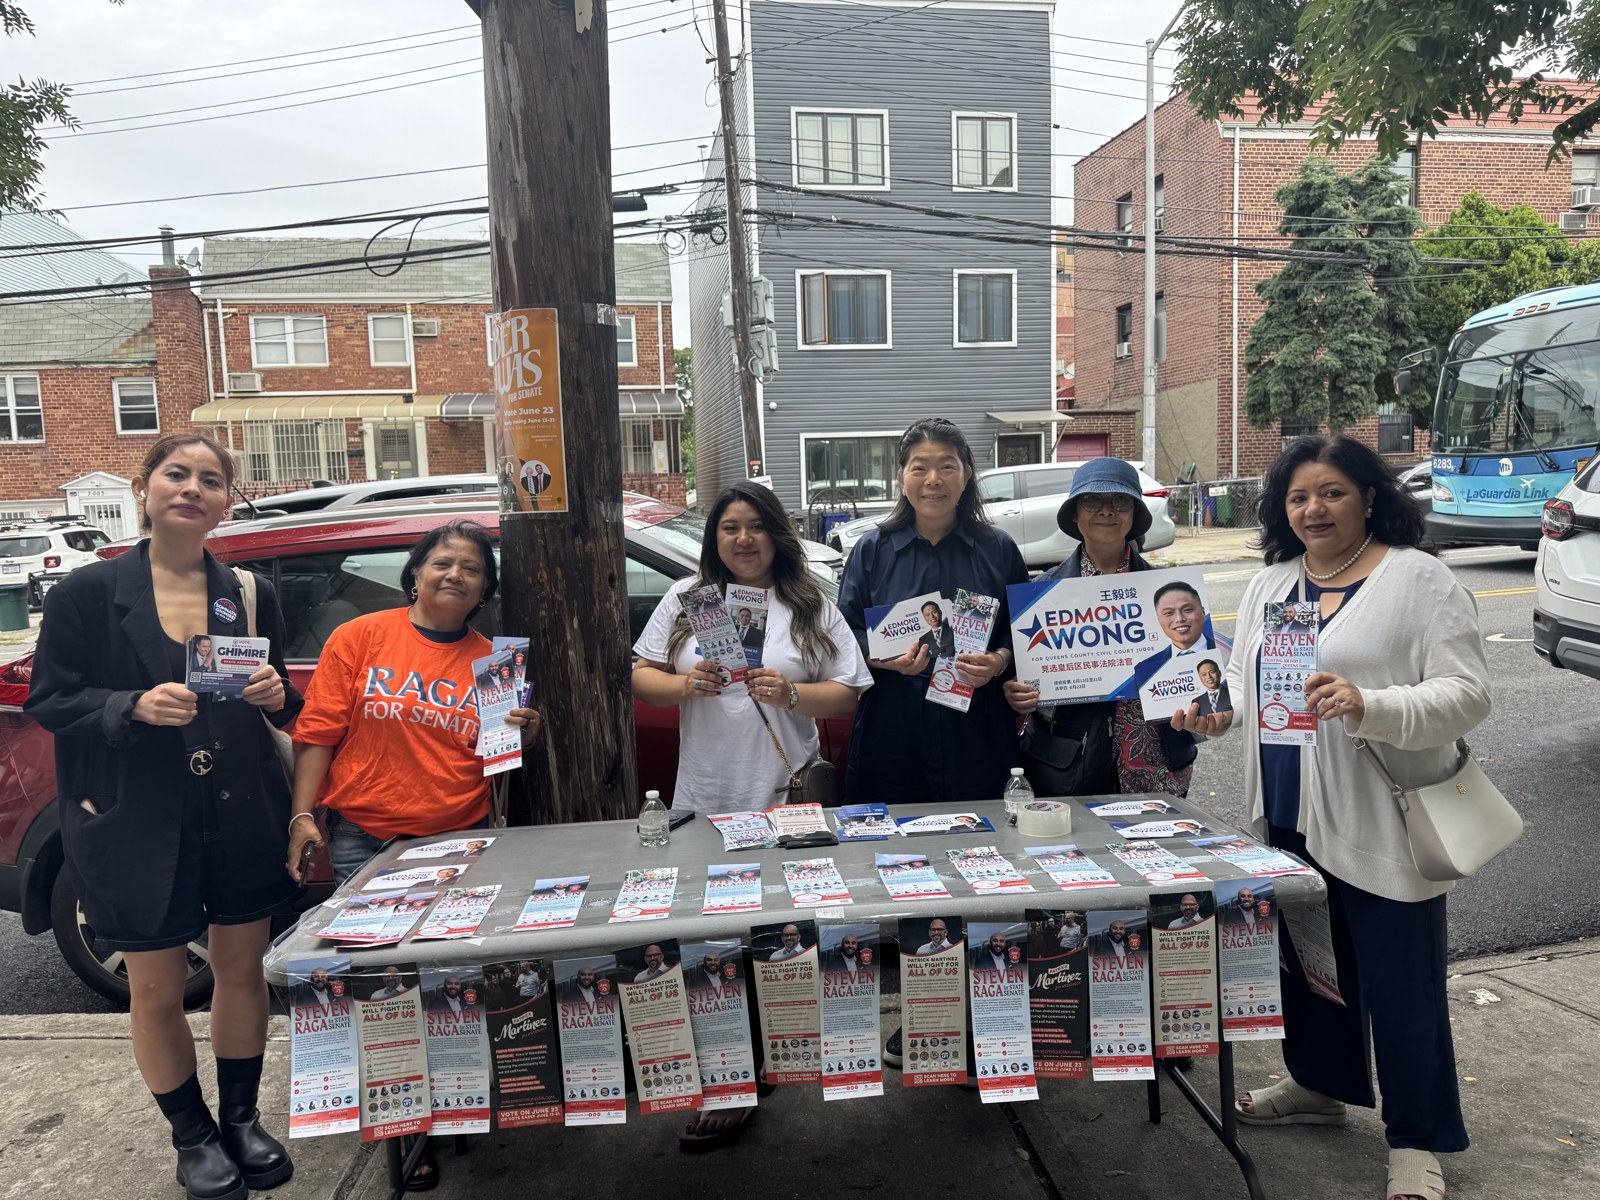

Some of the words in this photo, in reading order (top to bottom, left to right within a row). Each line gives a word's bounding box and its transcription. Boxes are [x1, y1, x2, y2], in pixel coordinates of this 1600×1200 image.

[518, 387, 542, 399] SENATE
[504, 409, 517, 417] Vote
[543, 406, 554, 414] 23
[1433, 458, 1452, 469] 6283
[1500, 462, 1510, 472] MTA
[1466, 487, 1521, 500] LaGuardia
[1524, 487, 1549, 500] Link
[738, 589, 763, 597] EDMOND
[738, 594, 763, 604] WONG
[690, 607, 728, 624] STEVEN
[1045, 603, 1142, 627] EDMOND
[693, 621, 717, 633] RAGA
[888, 617, 919, 630] EDMOND
[889, 623, 921, 637] WONG
[952, 614, 989, 633] STEVEN
[953, 625, 969, 637] AGA
[1048, 621, 1146, 650] WONG
[1264, 633, 1315, 646] STEVEN
[217, 647, 266, 658] GHIMIRE
[1264, 646, 1293, 656] RAGA
[1041, 658, 1133, 673] 竞选皇后区民事法院法官
[1157, 676, 1193, 688] EDMOND
[363, 667, 480, 717] RAGA
[480, 681, 513, 699] STEVEN
[1160, 683, 1195, 696] WONG
[481, 695, 500, 708] RAGA
[364, 701, 403, 720] FOR
[409, 705, 480, 740] SENATE
[1222, 921, 1274, 938] STEVEN
[1159, 942, 1178, 950] ALL
[1180, 941, 1193, 949] OF
[1222, 936, 1253, 950] RAGA
[1092, 955, 1144, 970] STEVEN
[762, 974, 781, 982] ALL
[800, 971, 813, 979] US
[824, 970, 875, 987] STEVEN
[907, 969, 927, 977] ALL
[928, 968, 943, 976] OF
[945, 967, 958, 975] US
[973, 969, 1024, 985] STEVEN
[1092, 970, 1123, 983] RAGA
[626, 984, 648, 992] PATRICK
[650, 979, 677, 987] MARTINEZ
[1029, 972, 1082, 990] Martinez
[628, 996, 648, 1005] ALL
[649, 992, 662, 1001] OF
[665, 989, 679, 998] US
[688, 984, 742, 1003] STEVEN
[823, 986, 854, 999] RAGA
[973, 985, 1004, 998] RAGA
[294, 1001, 350, 1022] STEVEN
[561, 1000, 614, 1017] STEVEN
[690, 1001, 721, 1016] RAGA
[362, 1014, 383, 1023] ALL
[385, 1012, 399, 1020] OF
[401, 1010, 416, 1018] US
[427, 1010, 481, 1025] STEVEN
[562, 1016, 593, 1029] RAGA
[294, 1019, 329, 1035] RAGA
[328, 1022, 351, 1030] SENATE
[428, 1025, 460, 1037] RAGA
[494, 1018, 547, 1042] Martinez
